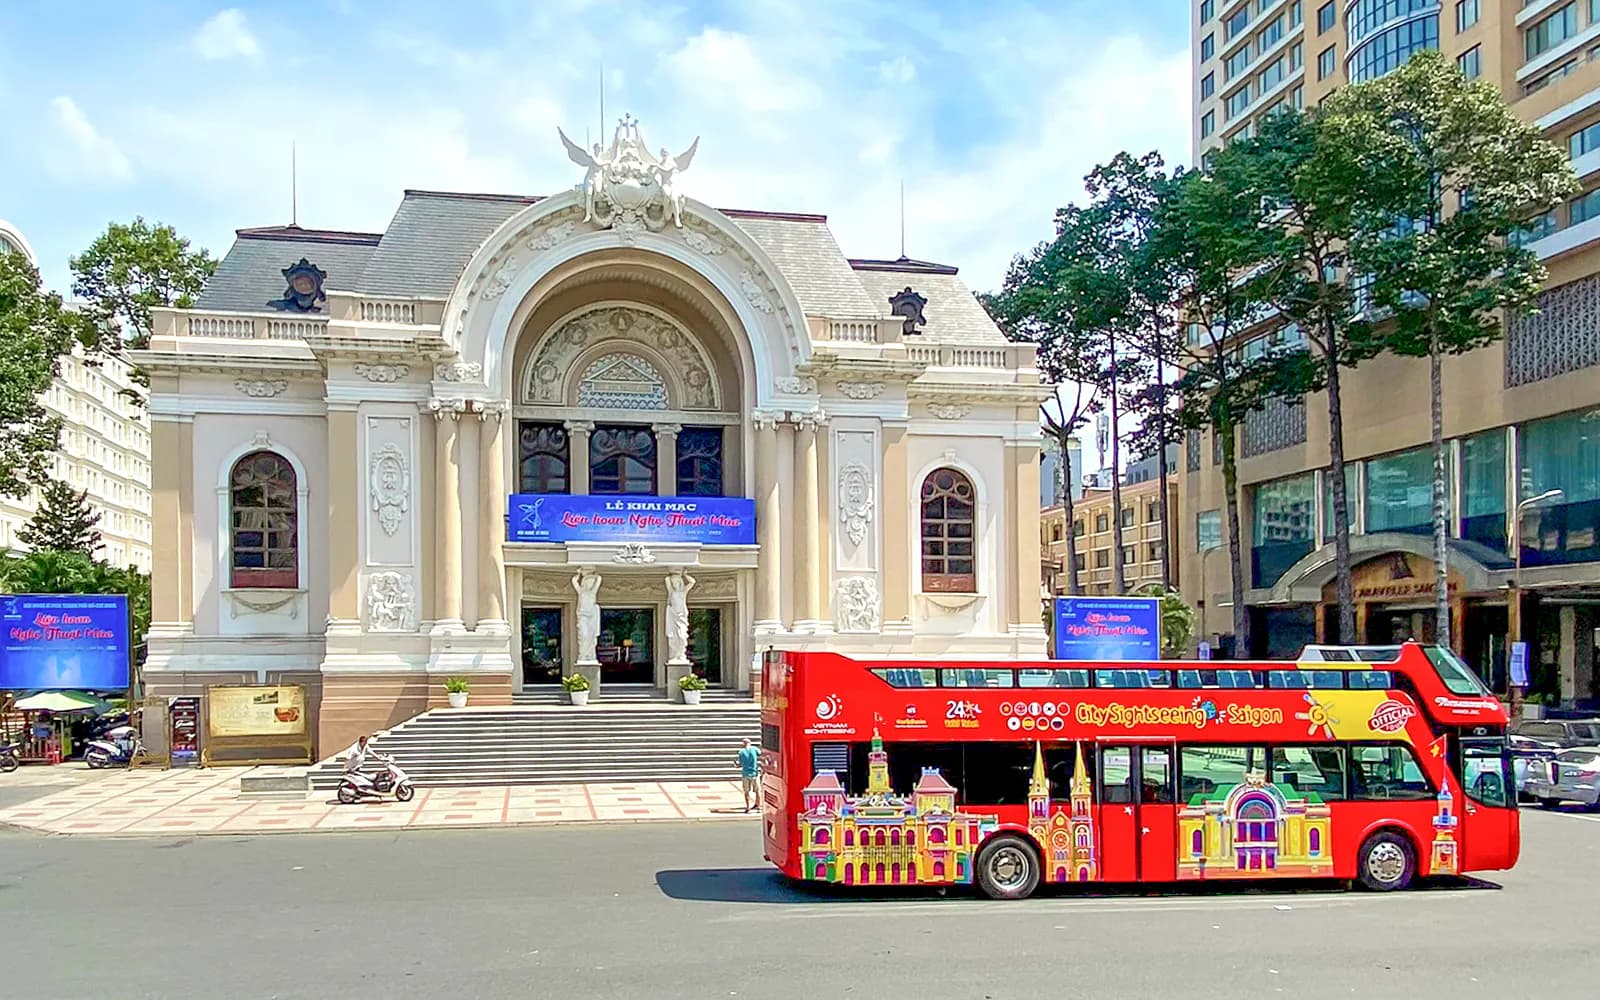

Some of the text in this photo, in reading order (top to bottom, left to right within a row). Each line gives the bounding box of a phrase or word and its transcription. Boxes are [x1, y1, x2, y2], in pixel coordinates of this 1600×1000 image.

[627, 502, 661, 511] KHAI
[1075, 702, 1206, 728] CitySightseeing
[1227, 703, 1283, 728] Saigon
[1371, 707, 1413, 728] OFFICIAL
